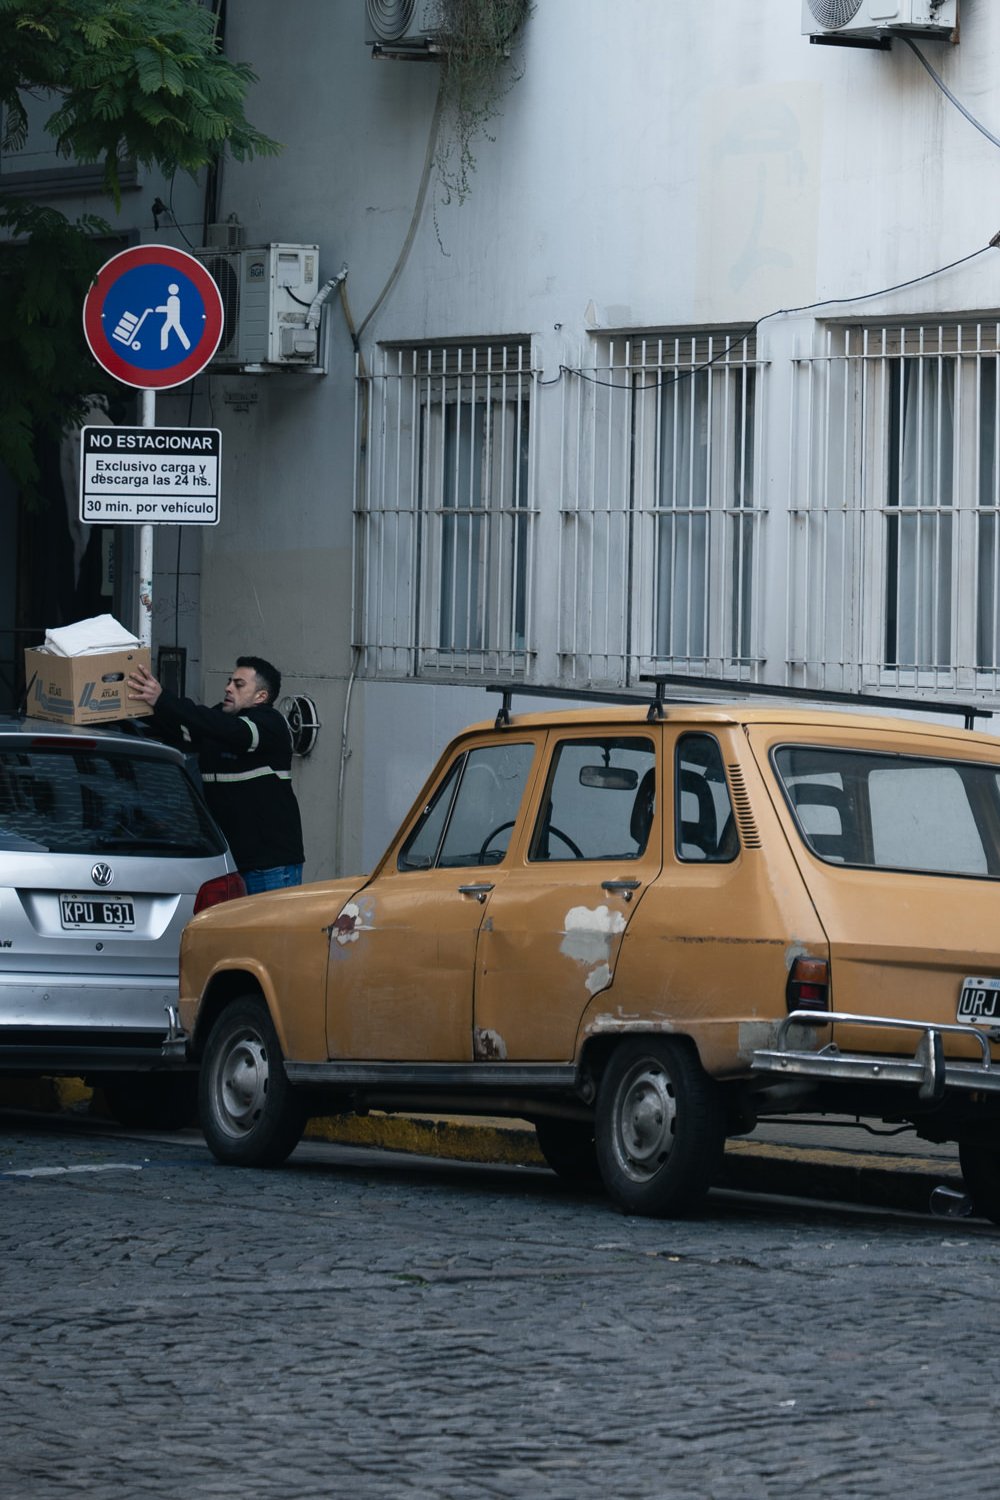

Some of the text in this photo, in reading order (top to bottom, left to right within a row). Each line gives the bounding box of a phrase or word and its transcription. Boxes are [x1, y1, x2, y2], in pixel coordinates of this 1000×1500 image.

[250, 268, 265, 277] BGH
[90, 434, 212, 450] NO ESTACIONAR
[96, 460, 207, 475] Exclusivo carga y
[91, 474, 211, 487] descarga las 24 hs.
[87, 500, 214, 515] 30 min. por vehículo
[48, 686, 62, 697] ATLAS
[101, 690, 119, 698] ATLAS
[63, 902, 133, 924] KPU 631
[962, 989, 998, 1016] URJ
